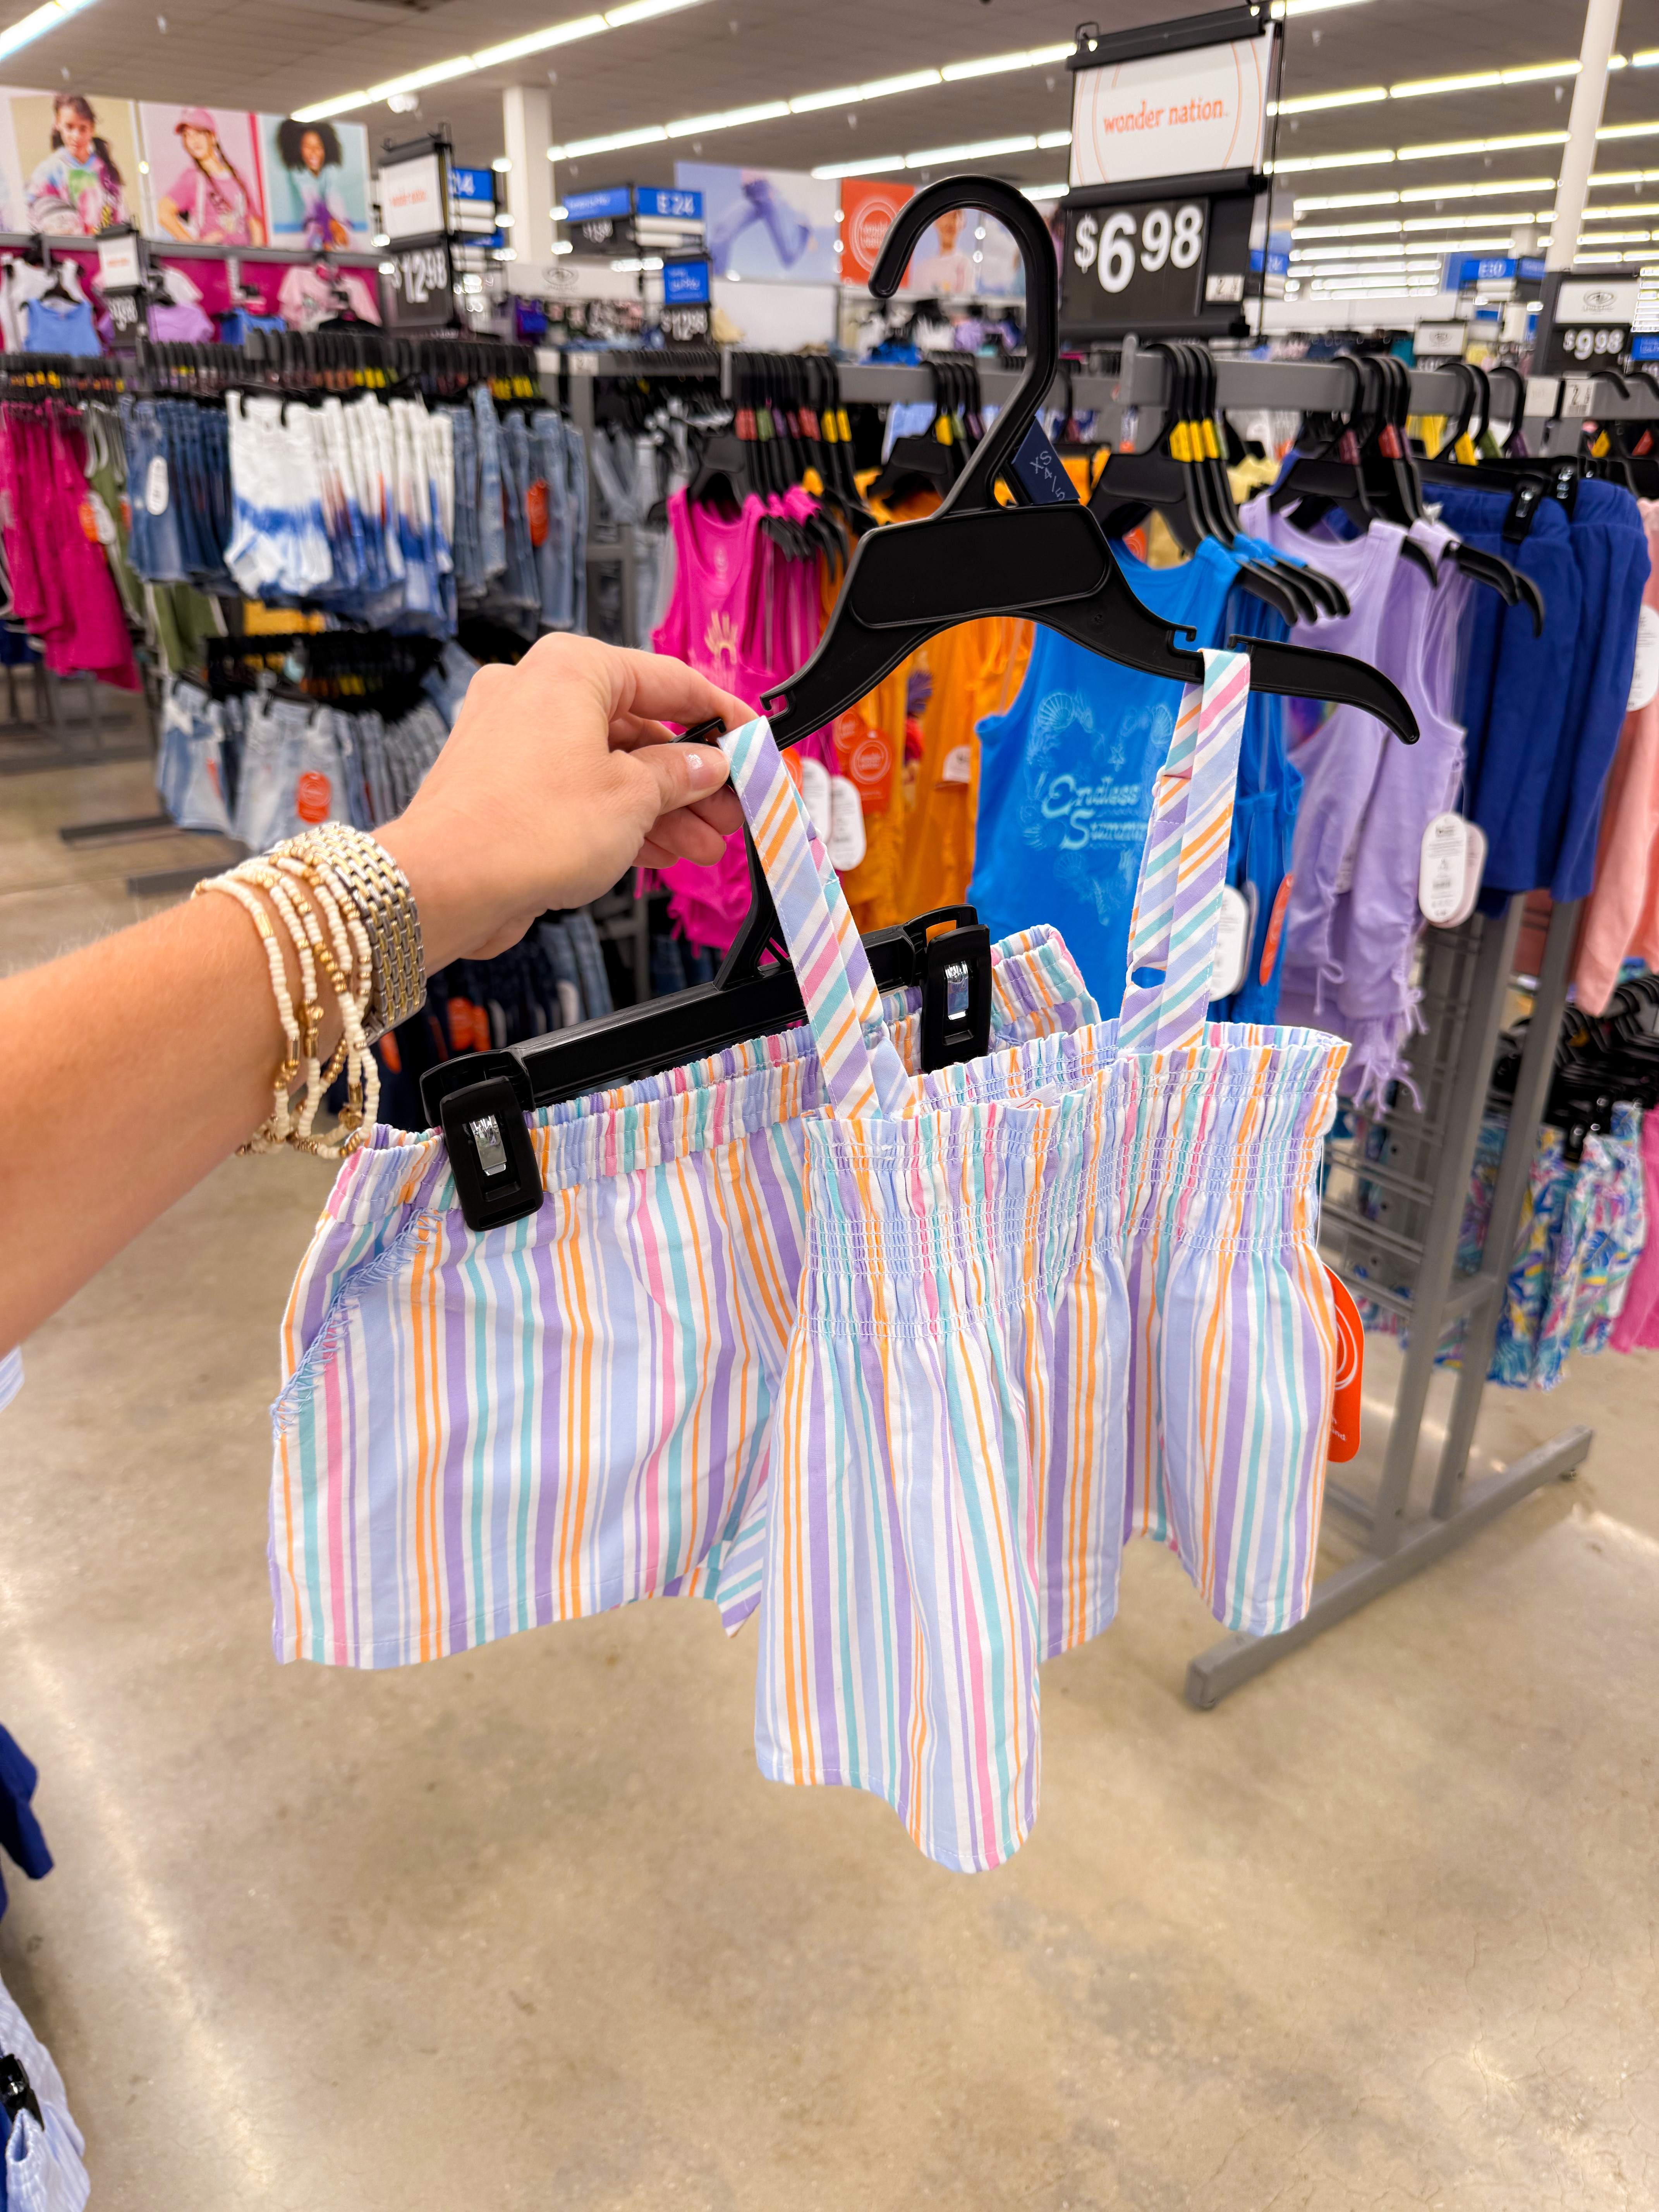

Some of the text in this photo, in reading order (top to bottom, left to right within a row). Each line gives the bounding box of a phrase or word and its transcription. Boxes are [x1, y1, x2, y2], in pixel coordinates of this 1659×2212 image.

[1103, 96, 1223, 134] wonder nation
[1029, 450, 1052, 474] XS
[1044, 467, 1065, 501] 4/5
[1041, 774, 1140, 819] Endless
